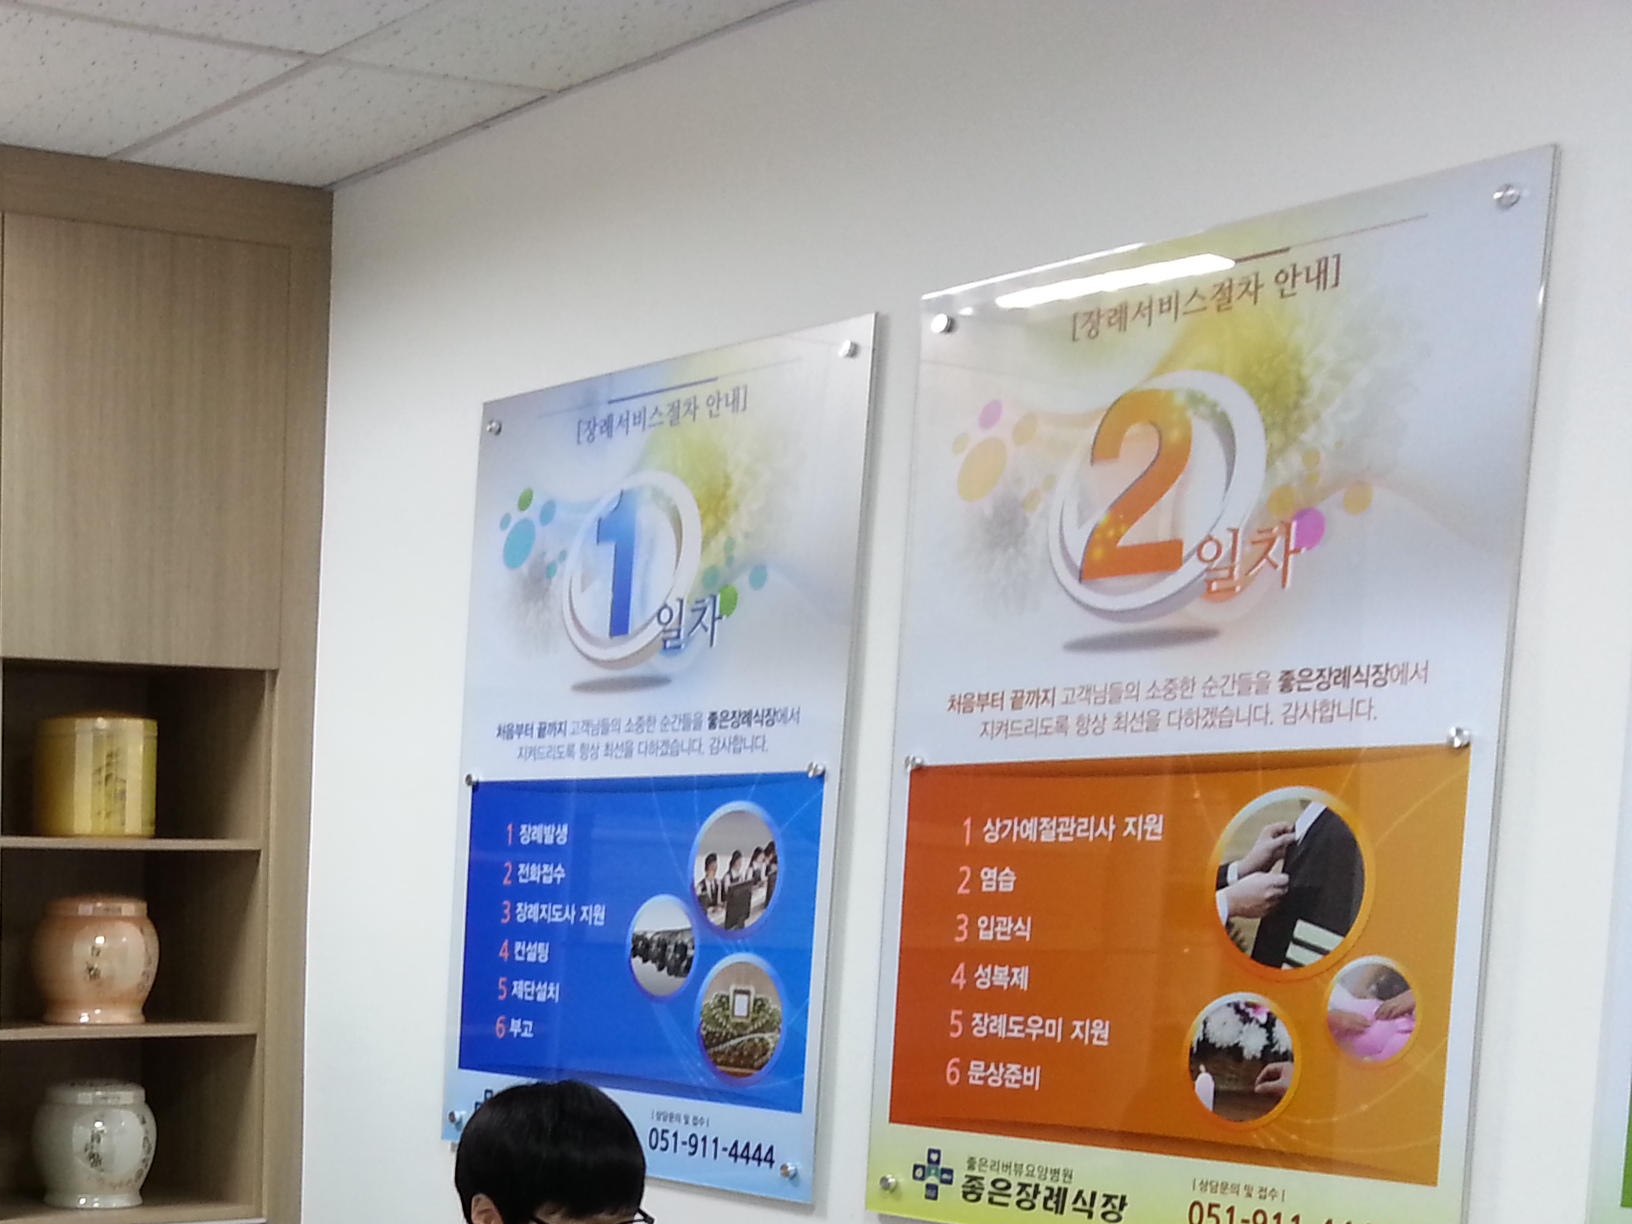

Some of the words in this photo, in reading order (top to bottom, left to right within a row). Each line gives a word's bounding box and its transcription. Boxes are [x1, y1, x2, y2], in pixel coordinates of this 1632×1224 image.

[1275, 253, 1342, 299] 안내]
[706, 384, 748, 419] 안내]
[1080, 388, 1193, 582] 2
[1196, 520, 1309, 594] 일차
[596, 489, 637, 638] 1
[657, 593, 723, 650] 일차
[947, 690, 1005, 714] 처음부터
[1010, 686, 1056, 711] 끝까지
[1061, 680, 1141, 706] 고객님들의
[1146, 676, 1196, 701] 소중한
[1202, 670, 1271, 697] 순간들을
[496, 721, 534, 740] 처음부터
[537, 720, 567, 738] 끝까지
[625, 714, 657, 735] 소중한
[980, 715, 1068, 740] 지켜드리도록
[1076, 713, 1107, 736] 항상
[1112, 709, 1160, 733] 최선을
[1167, 703, 1273, 730] 다하겠습니다.
[1283, 697, 1377, 725] 감사합니다.
[580, 742, 599, 760] 항상
[604, 740, 634, 758] 최선을
[507, 823, 513, 846] 1
[520, 823, 568, 845] 장례발생
[963, 817, 972, 846] 1
[983, 814, 1116, 843] 상가예절관리사
[1123, 813, 1164, 841] 지원
[503, 861, 512, 885] 2
[518, 862, 566, 884] 전화접수
[957, 865, 971, 894] 2
[980, 866, 1016, 892] 염습
[501, 900, 511, 923] 3
[516, 902, 576, 925] 장례지도사
[580, 904, 606, 926] 지원
[954, 913, 969, 942] 3
[977, 915, 1032, 942] 입관식
[499, 939, 509, 962] 4
[514, 940, 549, 963] 컨설팅
[498, 977, 507, 1000] 5
[511, 979, 560, 1003] 제단설치
[950, 962, 967, 991] 4
[974, 963, 1030, 991] 성복제
[496, 1015, 506, 1038] 6
[509, 1017, 534, 1038] 부고
[949, 1009, 963, 1038] 5
[971, 1012, 1063, 1043] 장례도우미
[1070, 1018, 1110, 1046] 지원
[946, 1057, 961, 1086] 6
[967, 1059, 1041, 1091] 문상준비
[648, 1127, 775, 1169] 051-911-4444
[961, 1174, 1128, 1224] 좋은장례식장
